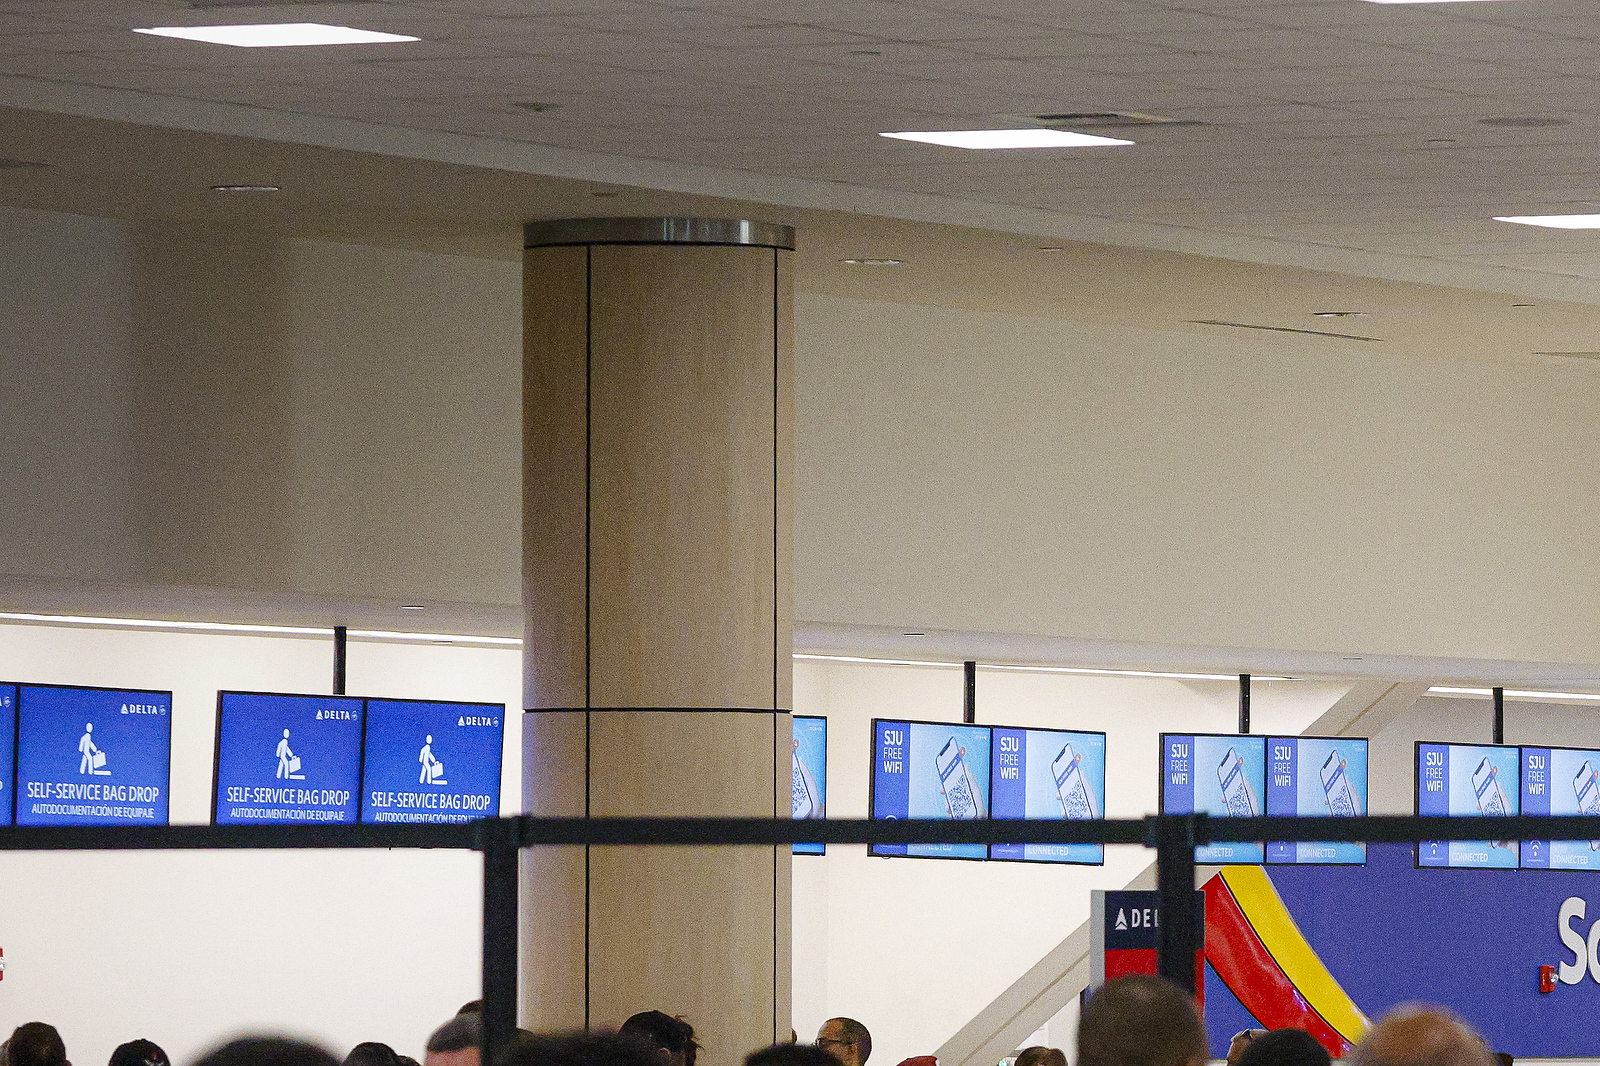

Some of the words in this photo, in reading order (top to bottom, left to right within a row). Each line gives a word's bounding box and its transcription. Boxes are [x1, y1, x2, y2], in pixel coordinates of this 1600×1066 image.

[129, 704, 158, 714] DELTA
[324, 710, 350, 720] DELTA
[466, 716, 492, 726] DELTA
[884, 730, 903, 745] SJU
[1000, 737, 1019, 752] SJU
[883, 747, 902, 760] FREE
[1171, 744, 1188, 758] SJU
[1274, 746, 1291, 760] SJU
[1000, 754, 1018, 766] FREE
[1426, 752, 1443, 766] SJU
[1528, 756, 1545, 769] SJU
[883, 760, 902, 774] WIFI
[1171, 760, 1188, 772] FREE
[1274, 762, 1291, 773] FREE
[1000, 767, 1018, 780] WIFI
[1171, 773, 1188, 785] WIFI
[1426, 768, 1443, 779] FREE
[1528, 771, 1544, 782] FREE
[1274, 775, 1291, 786] WIFI
[1426, 780, 1443, 792] WIFI
[27, 782, 101, 800] SELF-SERVICE
[103, 785, 126, 802] BAG
[129, 786, 159, 803] DROP
[1528, 783, 1545, 794] WIFI
[226, 786, 296, 804] SELF-SERVICE
[298, 789, 319, 805] BAG
[321, 790, 350, 806] DROP
[371, 792, 438, 809] SELF-SERVICE
[440, 794, 460, 810] BAG
[462, 795, 490, 810] DROP
[114, 806, 123, 817] DE
[124, 807, 154, 819] EQUIPAJE
[306, 810, 315, 820] DE
[316, 810, 345, 821] EQUIPAJE
